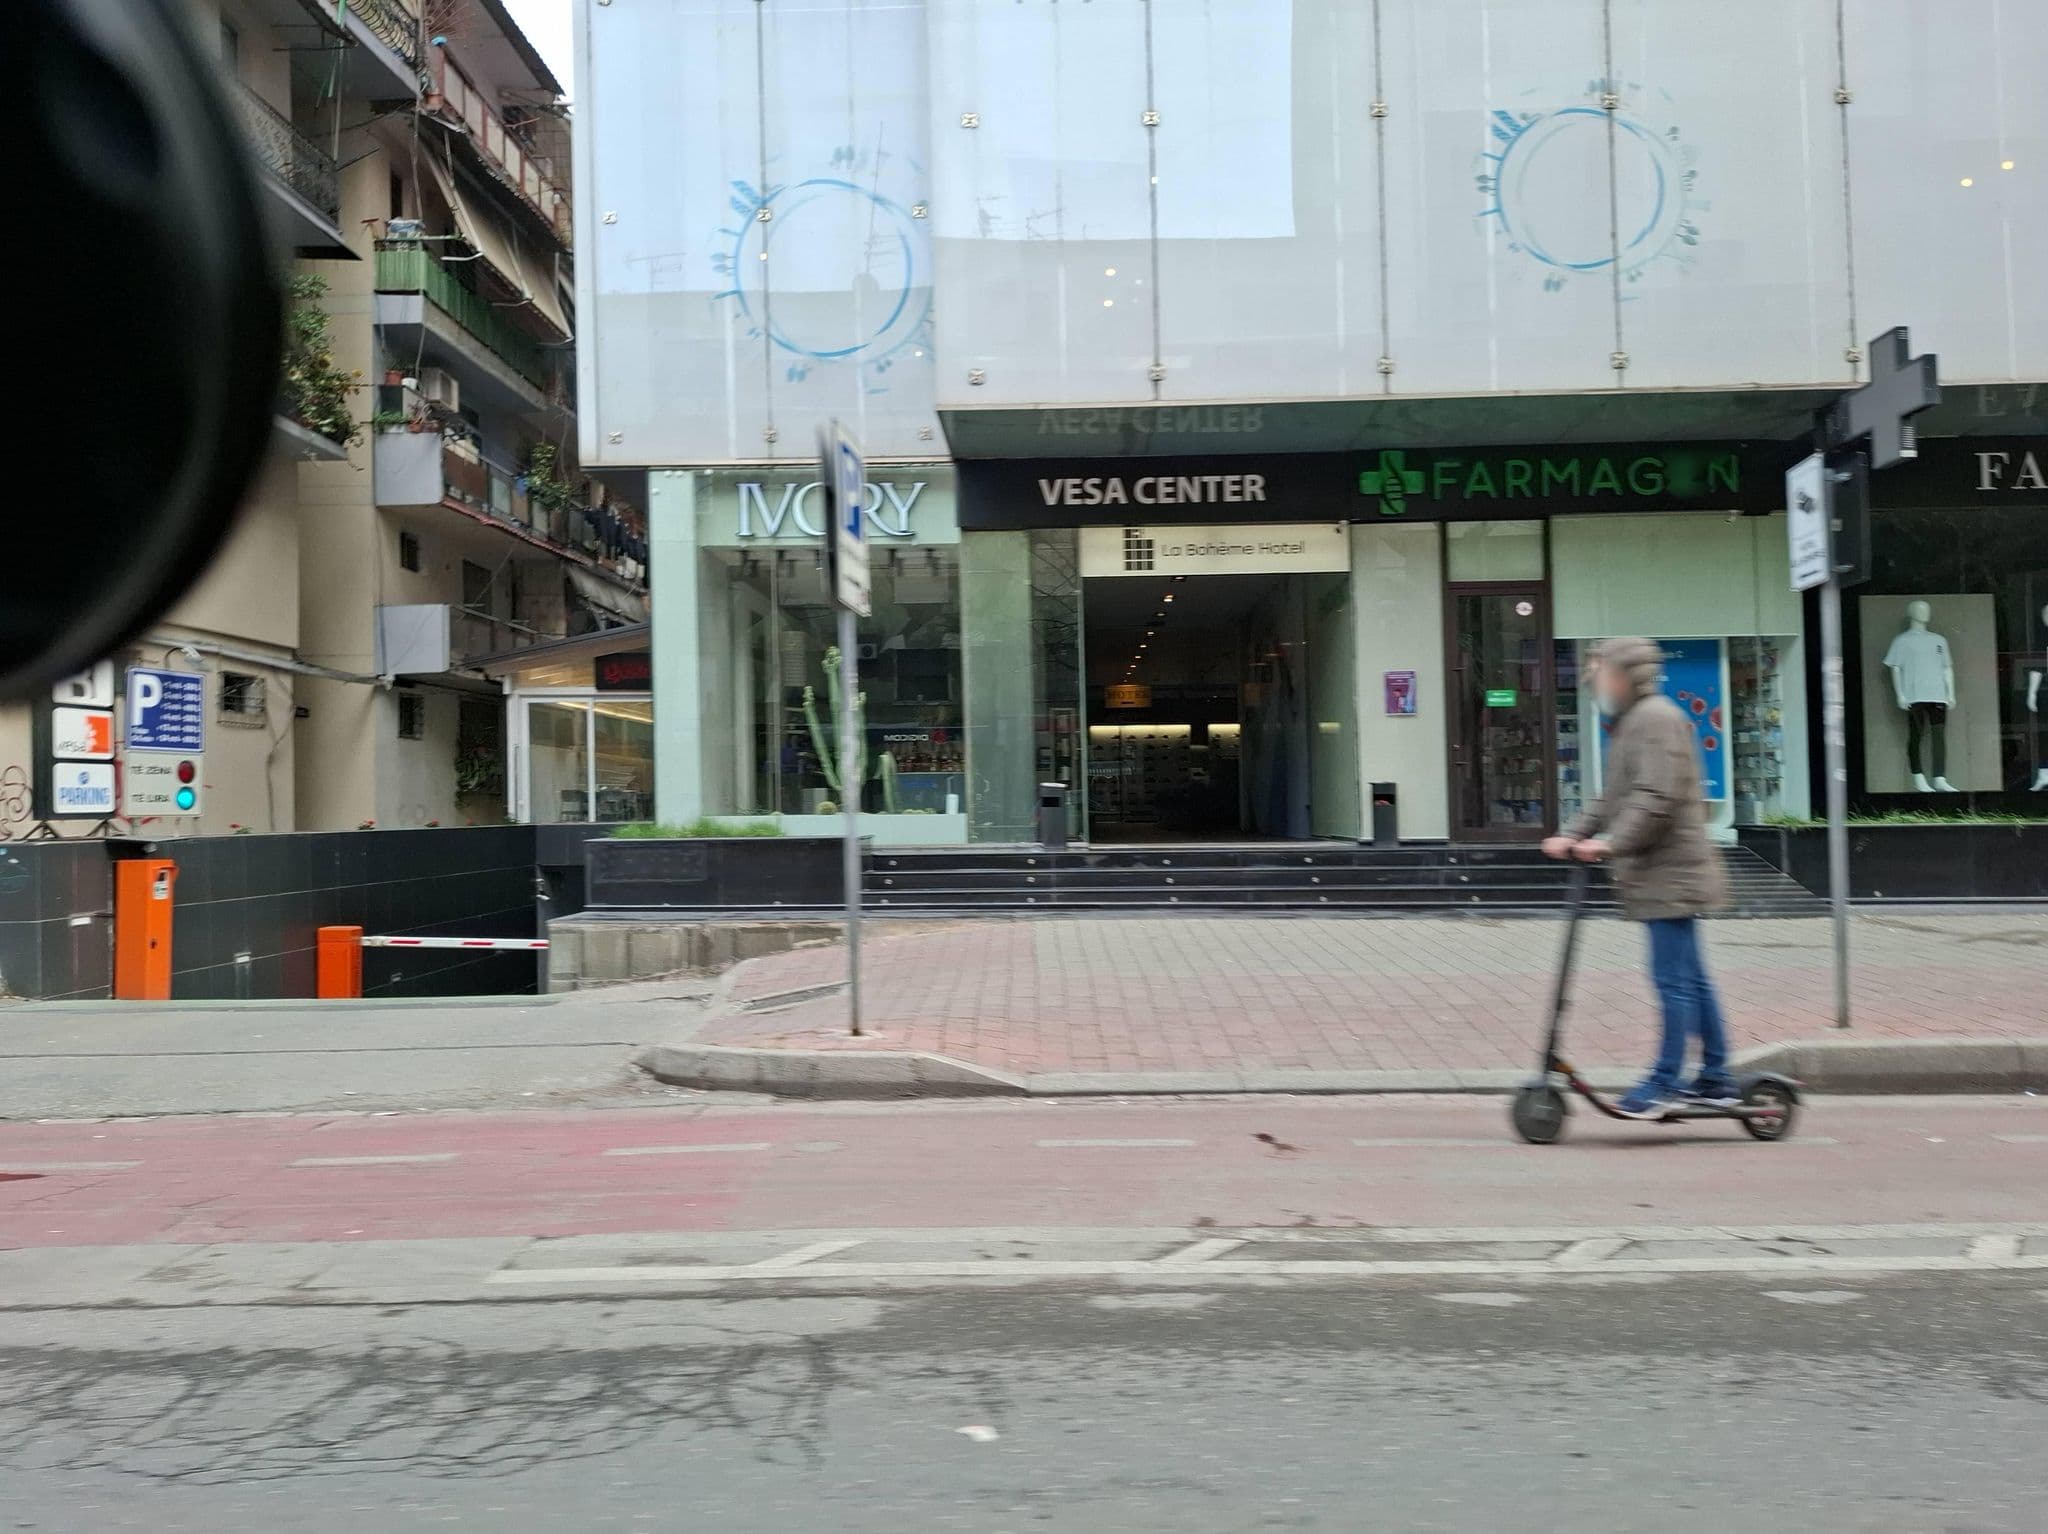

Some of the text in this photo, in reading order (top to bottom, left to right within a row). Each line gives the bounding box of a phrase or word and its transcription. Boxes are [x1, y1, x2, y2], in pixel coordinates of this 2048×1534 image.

[1038, 474, 1266, 506] VESA CENTER
[1432, 455, 1740, 500] FARMAGN
[1161, 543, 1182, 557] La
[1259, 540, 1305, 555] Hotel
[131, 673, 163, 727] P
[58, 786, 110, 806] PARKING
